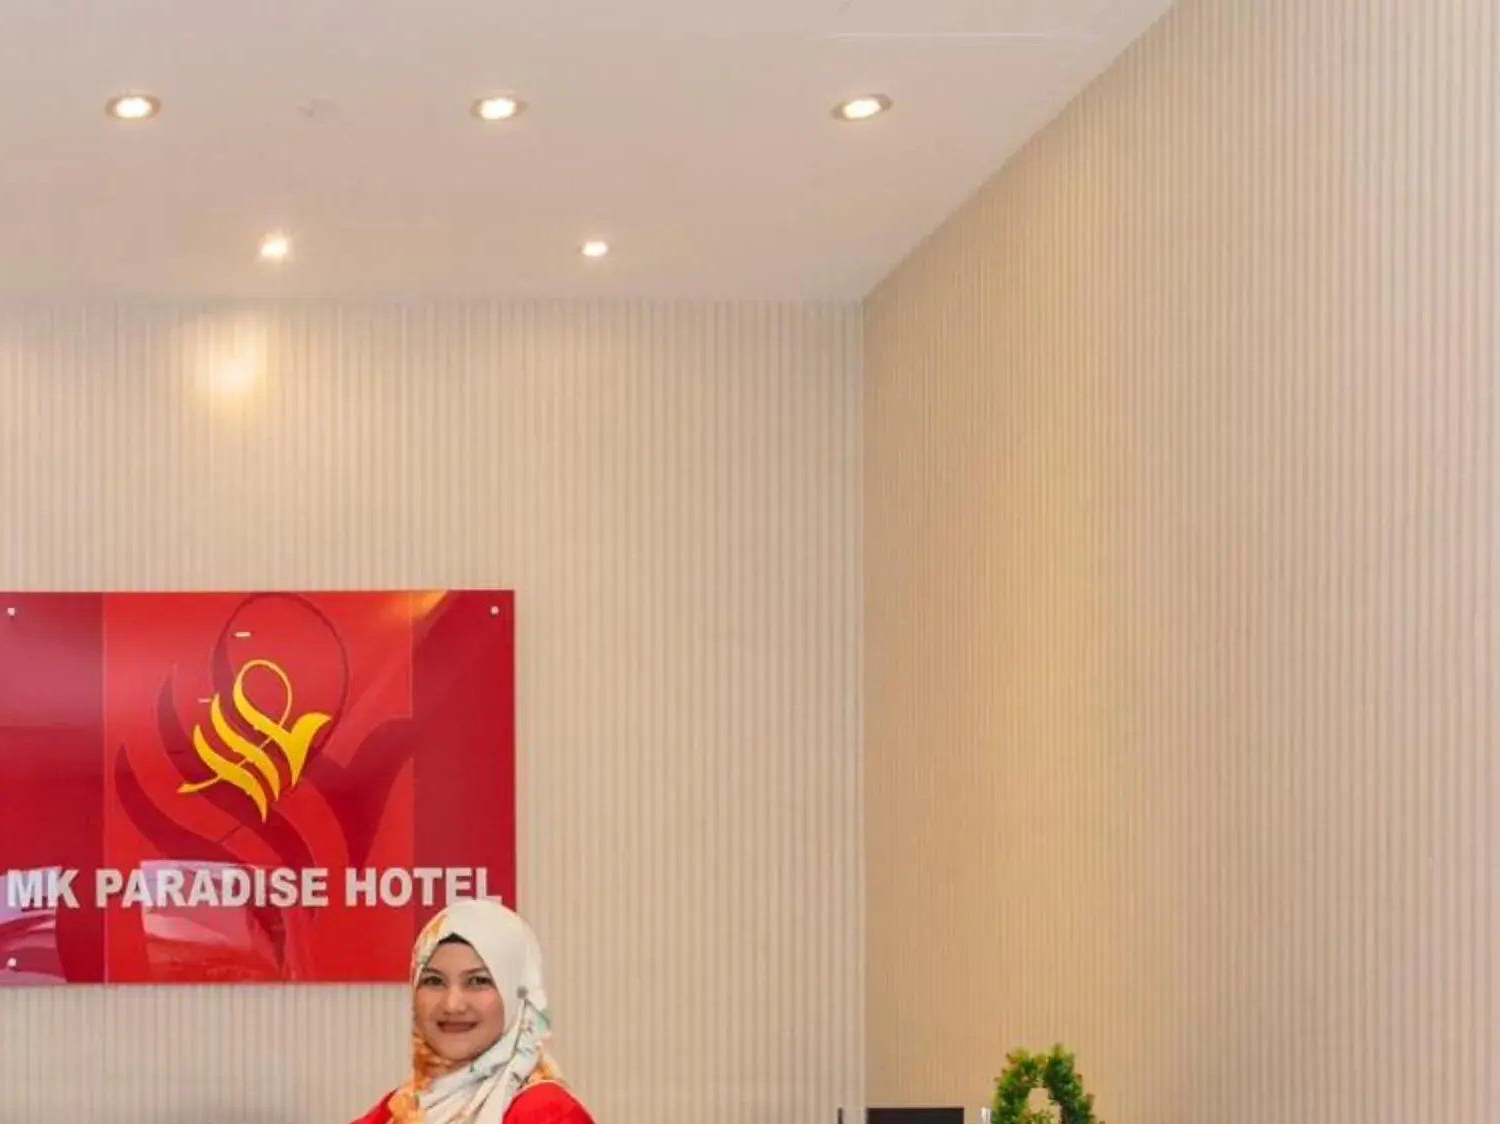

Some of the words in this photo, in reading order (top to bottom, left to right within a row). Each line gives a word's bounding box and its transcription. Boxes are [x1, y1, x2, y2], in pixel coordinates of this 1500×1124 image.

[6, 869, 79, 908] MK
[96, 867, 328, 908] PARADISE
[345, 867, 503, 907] HOTEL
